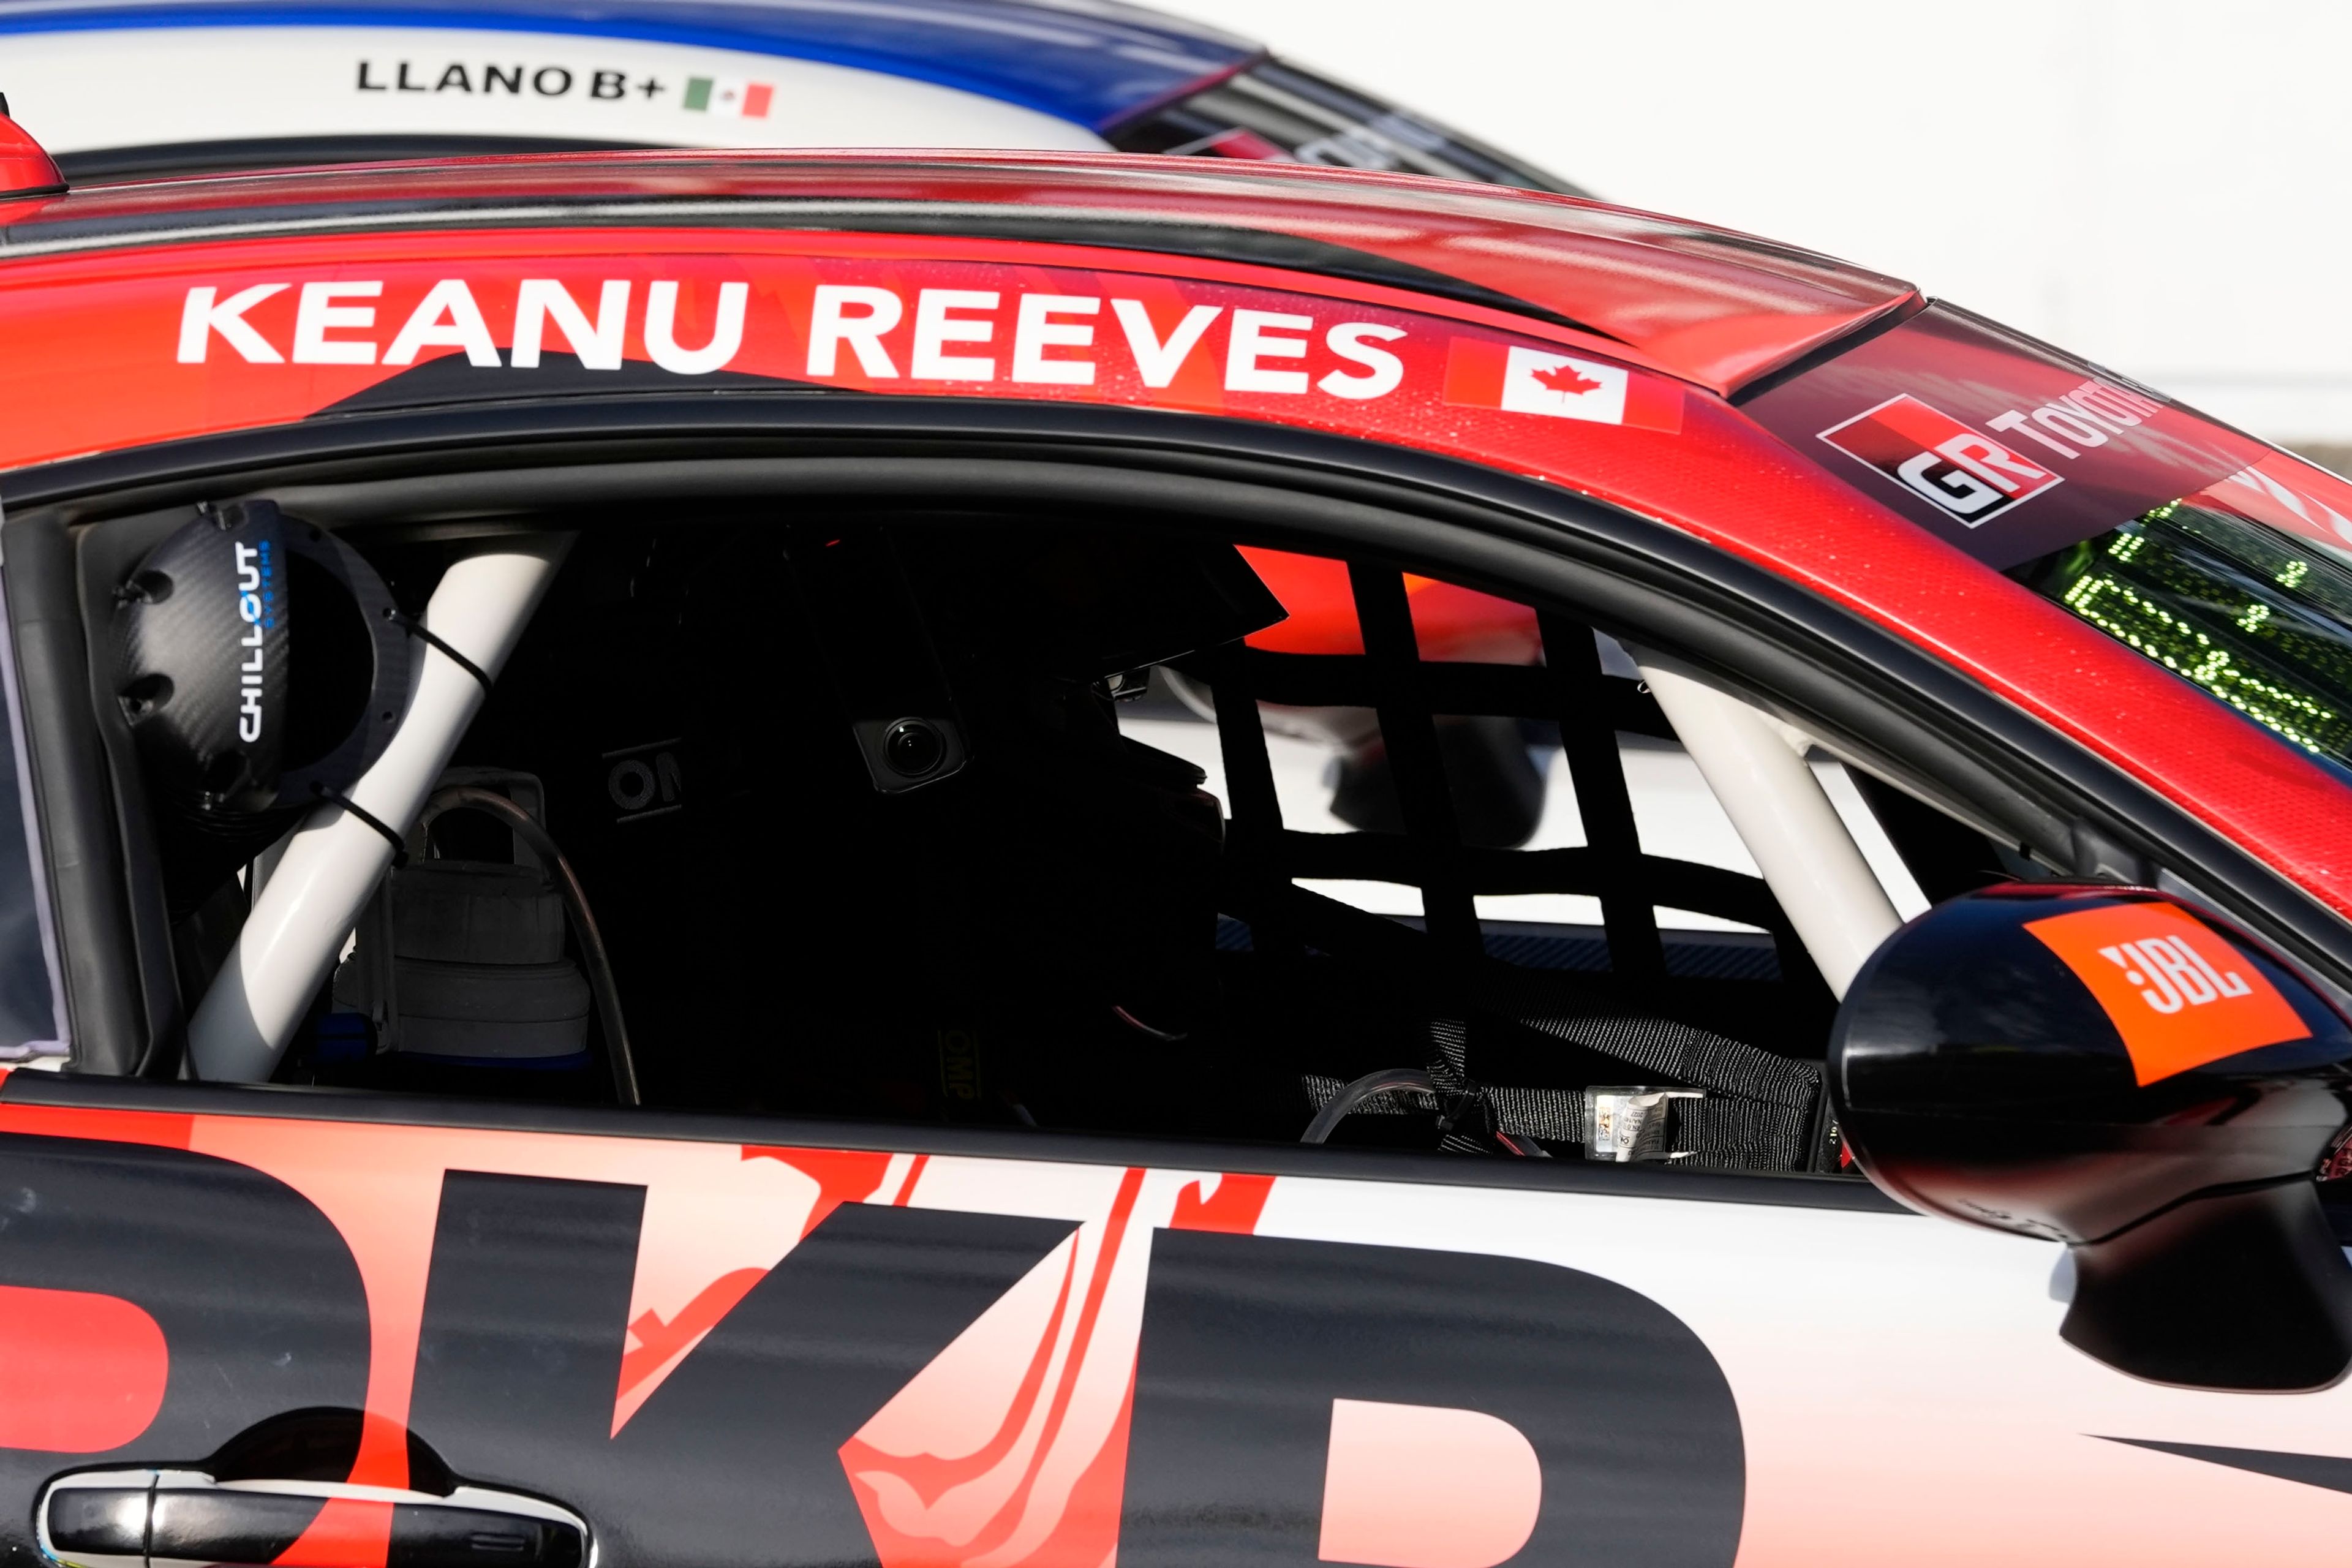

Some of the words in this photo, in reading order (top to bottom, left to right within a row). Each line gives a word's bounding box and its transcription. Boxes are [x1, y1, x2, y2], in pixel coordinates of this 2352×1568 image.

[356, 61, 574, 97] LLANO
[589, 70, 664, 100] B+
[177, 279, 750, 375] KEANU
[805, 284, 1407, 401] REEVES
[1898, 432, 2048, 514] GR
[235, 541, 263, 744] CHILLOUT
